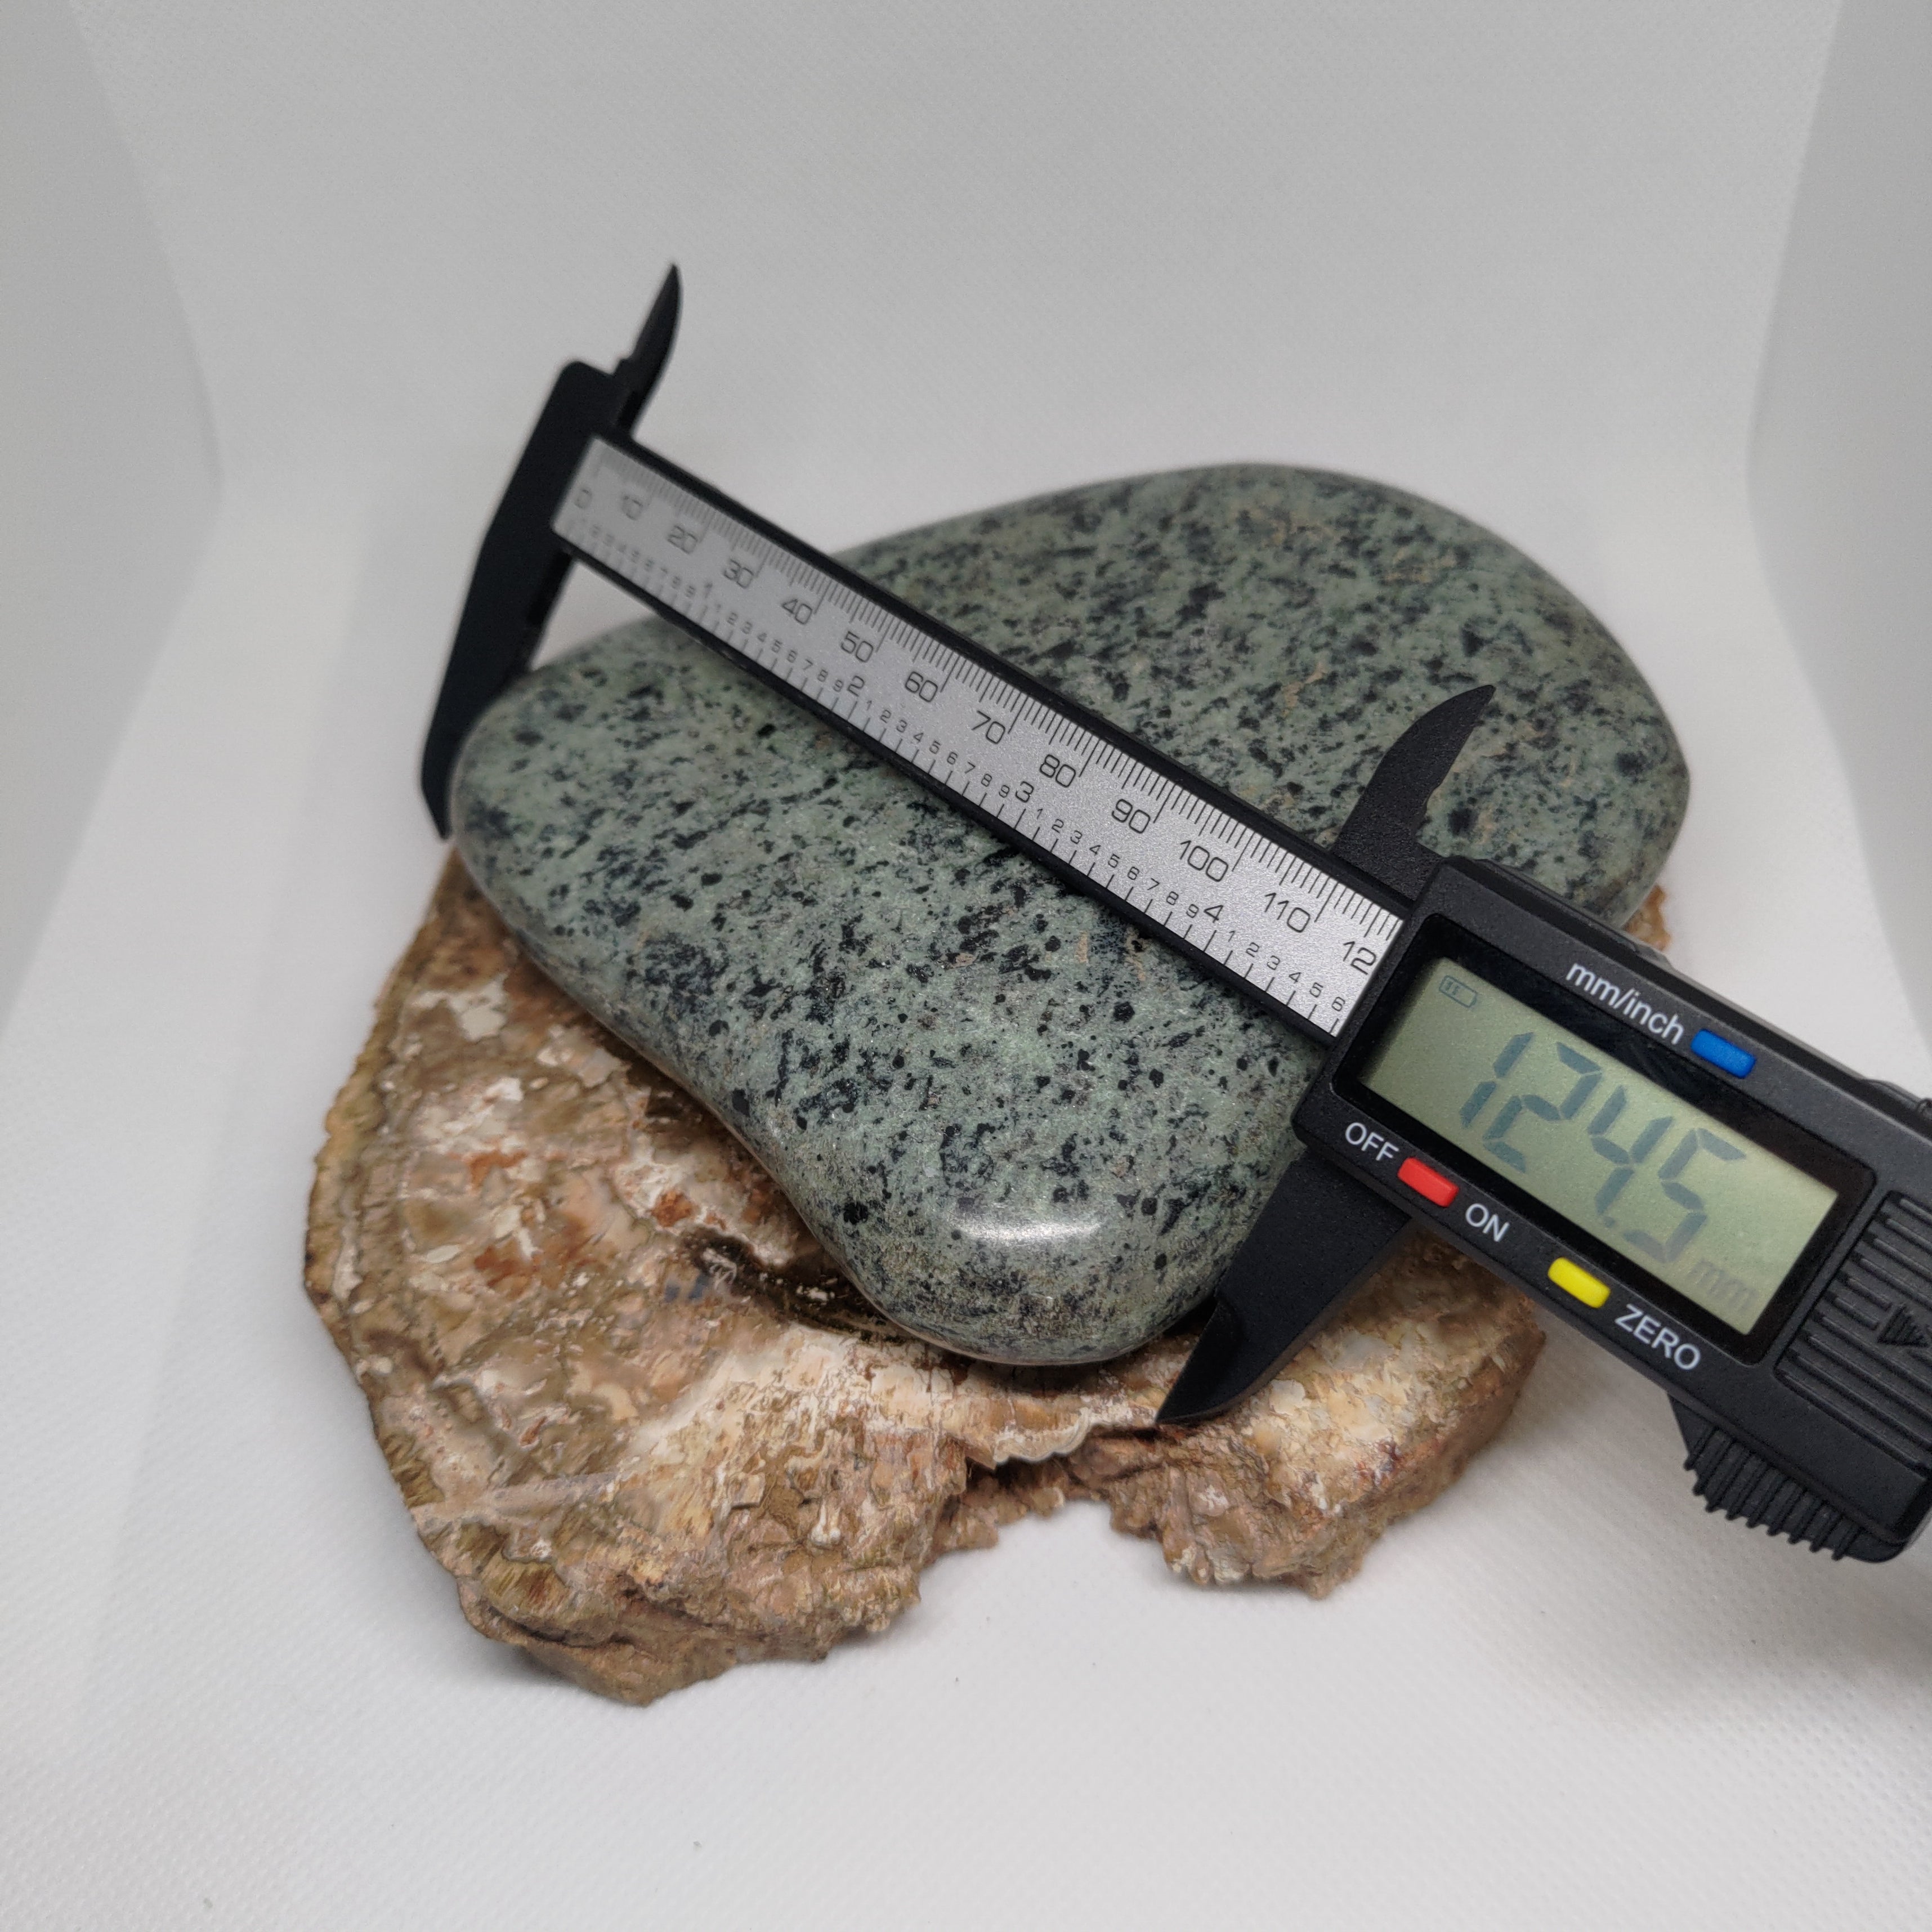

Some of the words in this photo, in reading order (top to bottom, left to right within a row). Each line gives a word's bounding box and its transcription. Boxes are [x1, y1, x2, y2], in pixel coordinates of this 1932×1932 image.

[667, 525, 698, 554] 20
[723, 558, 754, 589] 30
[781, 598, 813, 625] 40
[840, 631, 874, 663] 50
[905, 671, 938, 703] 60
[972, 710, 1005, 744] 70
[1039, 754, 1076, 788] 80
[1111, 799, 1151, 834] 90
[1179, 840, 1229, 882] 100
[1264, 892, 1311, 933] 110
[771, 639, 783, 653] 5
[787, 649, 798, 663] 6
[802, 658, 814, 671] 7
[817, 669, 829, 683] 8
[832, 679, 844, 692] 9
[847, 676, 865, 697] 2
[879, 709, 892, 723] 2
[896, 719, 908, 733] 3
[913, 732, 924, 743] 4
[929, 740, 941, 754] 5
[947, 752, 958, 765] 6
[964, 762, 976, 773] 7
[981, 773, 992, 787] 8
[998, 785, 1010, 798] 9
[1015, 781, 1035, 803] 3
[1036, 808, 1043, 820] 1
[1052, 819, 1064, 833] 2
[1070, 830, 1083, 844] 3
[1089, 844, 1101, 856] 4
[1108, 854, 1121, 868] 5
[1127, 866, 1140, 880] 6
[1147, 878, 1160, 891] 7
[1166, 891, 1179, 905] 8
[1186, 904, 1199, 918] 9
[1204, 905, 1224, 923] 4
[1228, 931, 1236, 942] 1
[1245, 942, 1260, 958] 2
[1267, 955, 1281, 971] 3
[1288, 972, 1302, 983] 4
[1309, 982, 1323, 998] 5
[1331, 996, 1345, 1012] 6
[1565, 961, 1685, 1045] mm/inch
[1344, 1121, 1400, 1163] OFF
[1464, 1203, 1510, 1242] ON
[1614, 1303, 1702, 1371] ZERO
